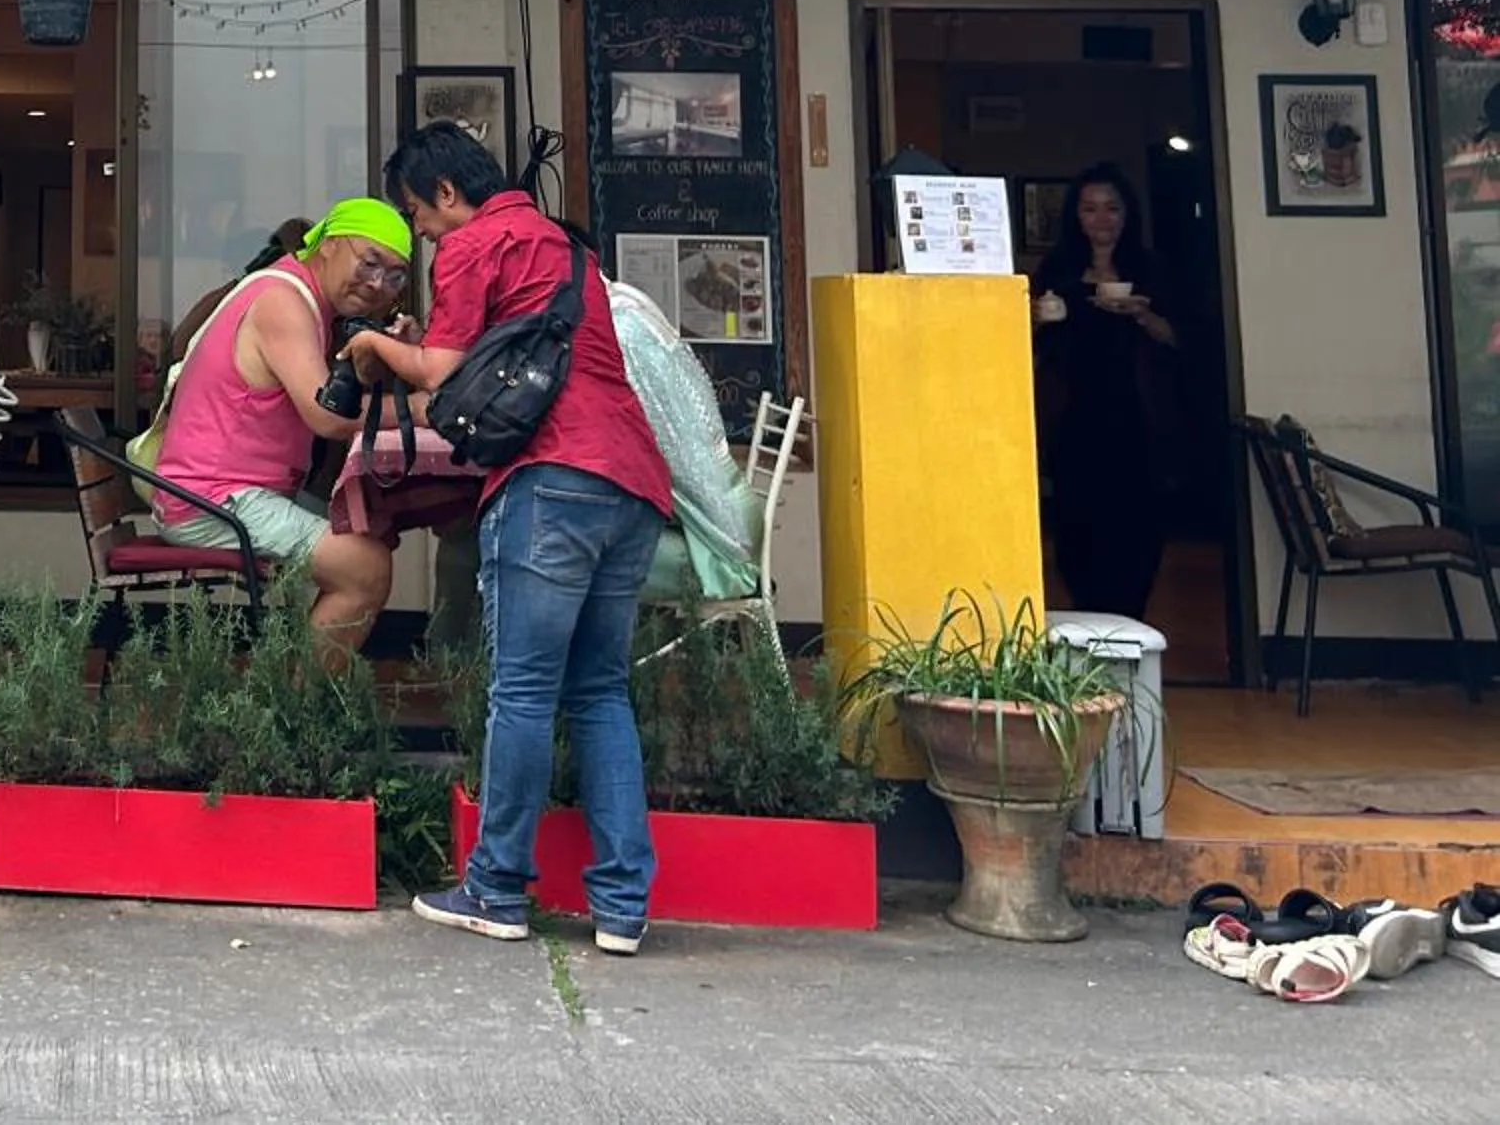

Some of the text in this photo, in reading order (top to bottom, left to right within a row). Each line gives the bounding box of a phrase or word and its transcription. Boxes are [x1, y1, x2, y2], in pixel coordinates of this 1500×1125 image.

[646, 159, 662, 173] TO
[667, 159, 693, 174] OUR
[636, 204, 682, 222] Coffee
